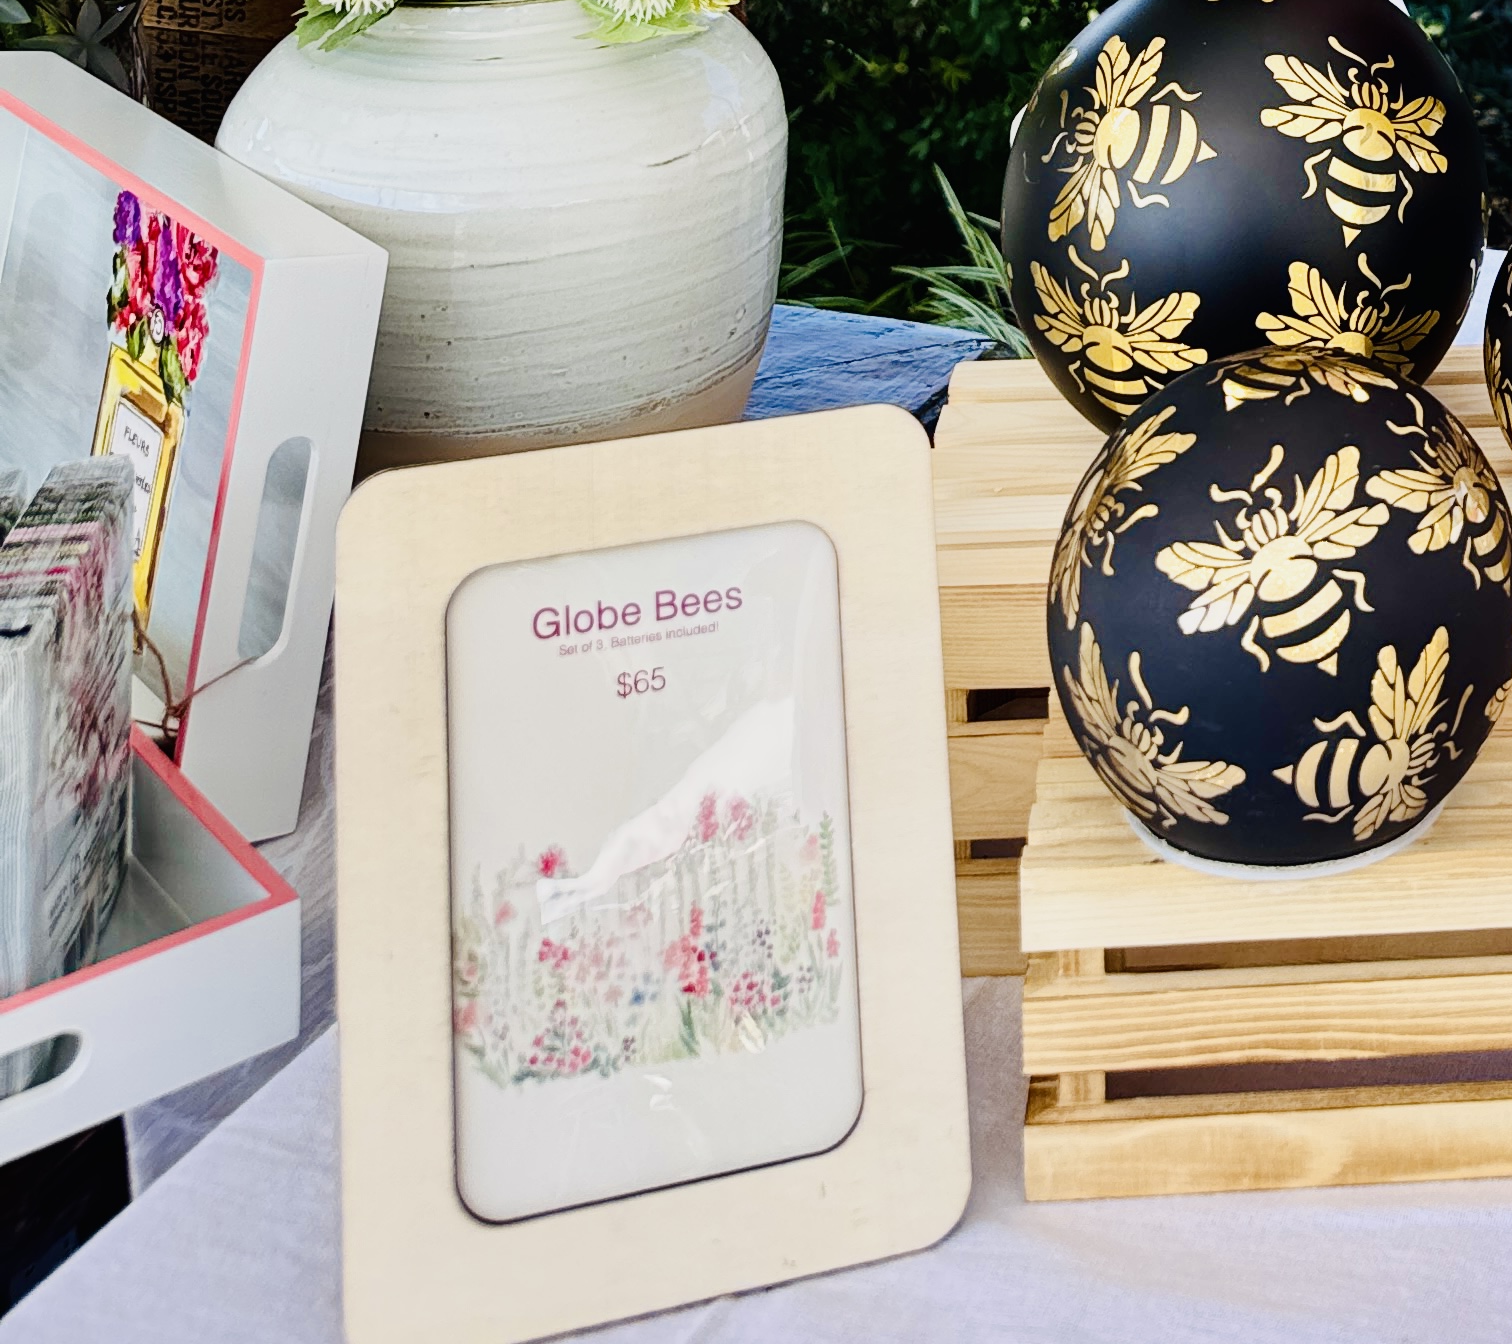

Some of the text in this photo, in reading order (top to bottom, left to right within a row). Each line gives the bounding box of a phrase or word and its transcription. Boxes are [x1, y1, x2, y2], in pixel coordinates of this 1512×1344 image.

[532, 586, 743, 640] Globe Bees
[559, 642, 578, 657] Set
[582, 640, 593, 653] of
[611, 631, 662, 649] Batteries
[665, 621, 720, 640] included!
[616, 666, 667, 699] $65
